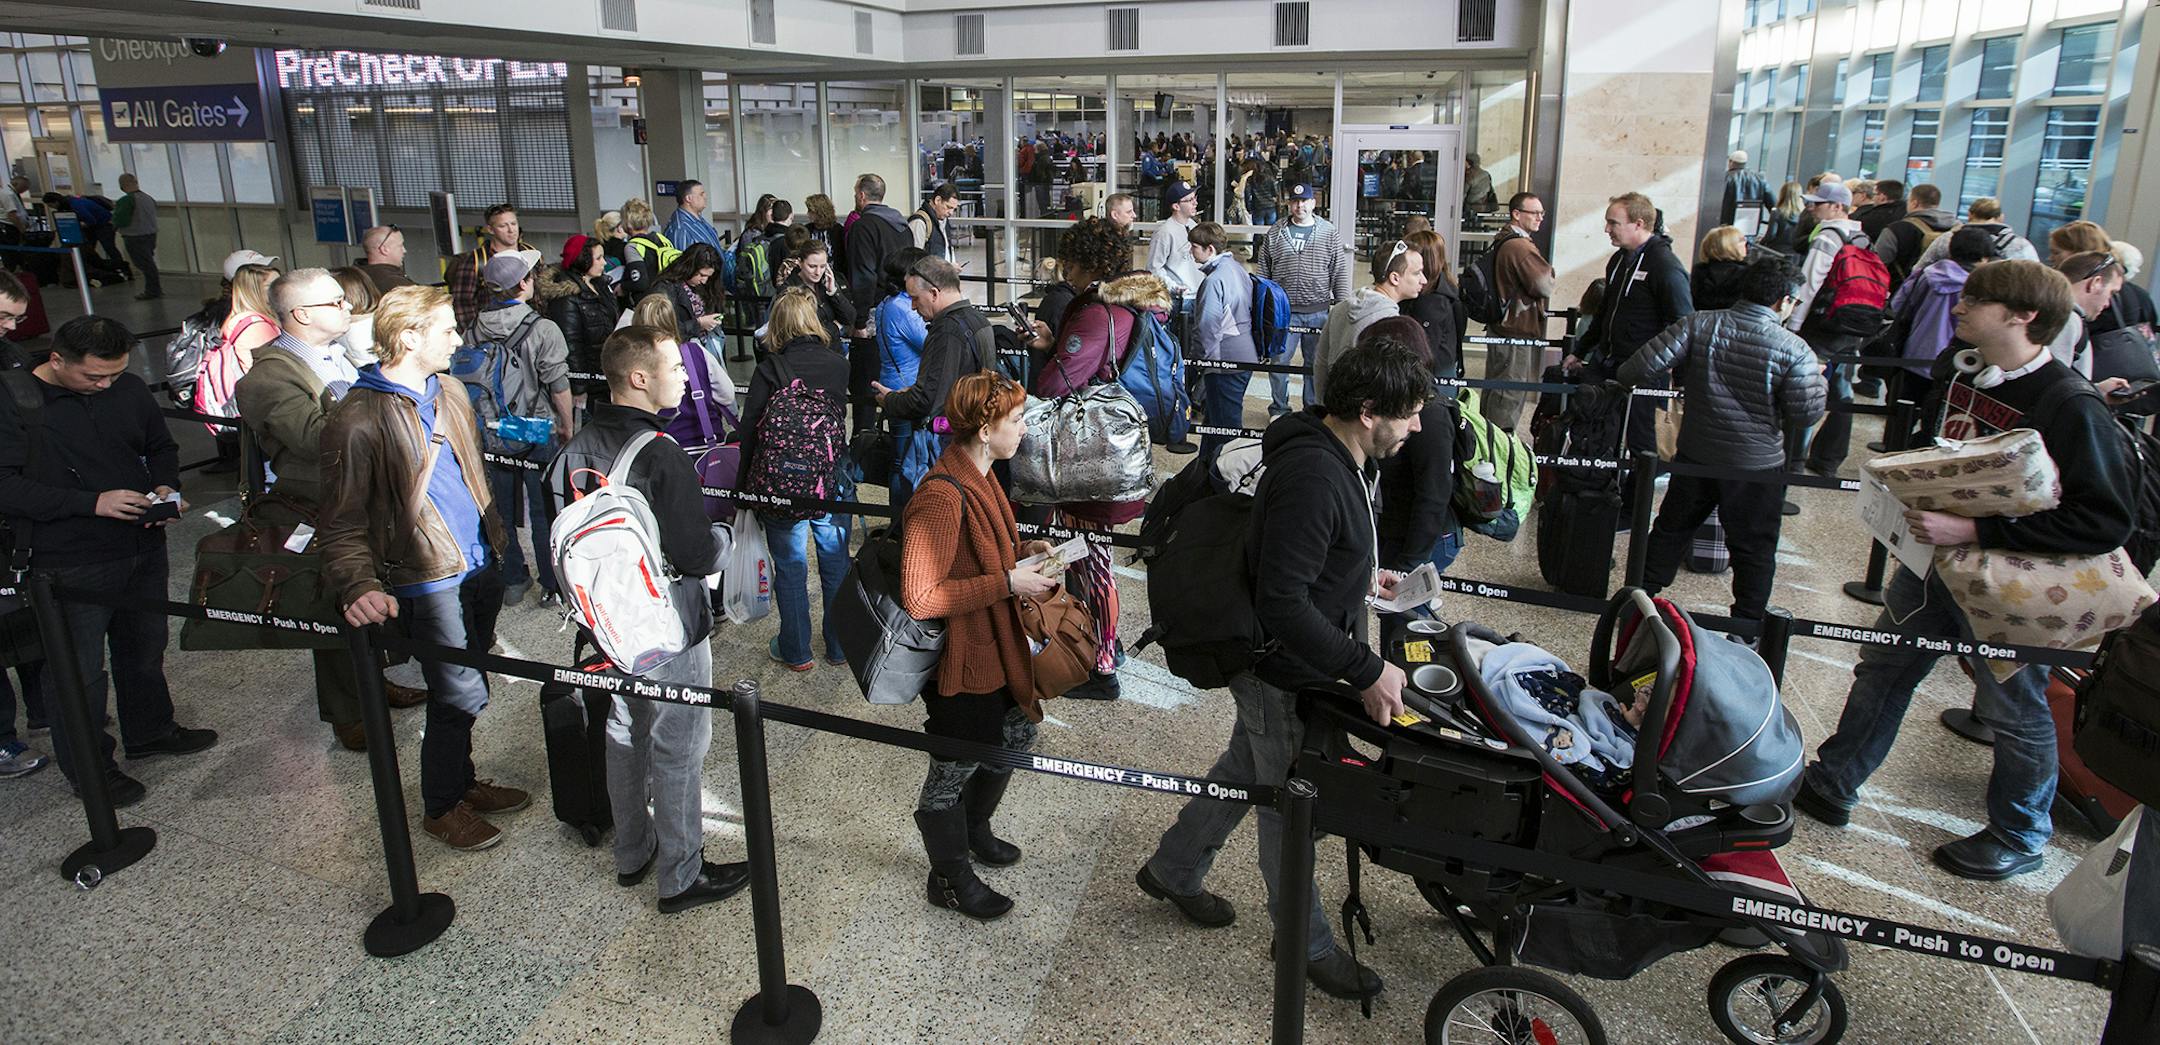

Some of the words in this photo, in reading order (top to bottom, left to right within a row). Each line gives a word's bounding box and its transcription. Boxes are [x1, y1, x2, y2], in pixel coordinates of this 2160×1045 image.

[133, 101, 157, 128] All
[163, 100, 227, 127] Gates
[1449, 378, 1467, 387] Open
[1632, 388, 1679, 397] EMERGENCY
[1195, 425, 1242, 436] EMERGENCY
[500, 455, 514, 465] Push
[515, 459, 522, 467] to
[523, 459, 539, 469] Open
[1557, 457, 1578, 466] Push
[1582, 458, 1591, 467] to
[1594, 458, 1617, 468] Open
[739, 491, 758, 501] Push
[760, 494, 768, 503] to
[771, 495, 791, 506] Open
[1049, 527, 1071, 538] Push
[1075, 530, 1085, 538] to
[1088, 532, 1112, 543] Open
[1440, 580, 1456, 590] sh
[1461, 582, 1473, 592] to
[1478, 584, 1508, 598] Open
[206, 608, 263, 625] EMERGENCY
[273, 616, 297, 629] Push
[299, 620, 310, 630] to
[312, 622, 338, 634] Open
[595, 603, 622, 645] patagonia
[1813, 624, 1901, 646] EMERGENCY
[1916, 637, 1951, 652] Push
[1957, 642, 1973, 654] to
[1978, 644, 2016, 659] Open
[553, 668, 623, 691] EMERGENCY
[634, 681, 661, 697] Push
[665, 686, 678, 700] to
[681, 688, 711, 705] Open
[1032, 756, 1125, 783] EMERGENCY
[1142, 774, 1179, 791] Push
[1185, 780, 1201, 794] to
[1208, 783, 1249, 800] Open
[1732, 897, 1869, 937] EMERGENCY
[1894, 927, 1949, 953] Push
[1959, 940, 1983, 958] to
[1993, 946, 2055, 972] Open
